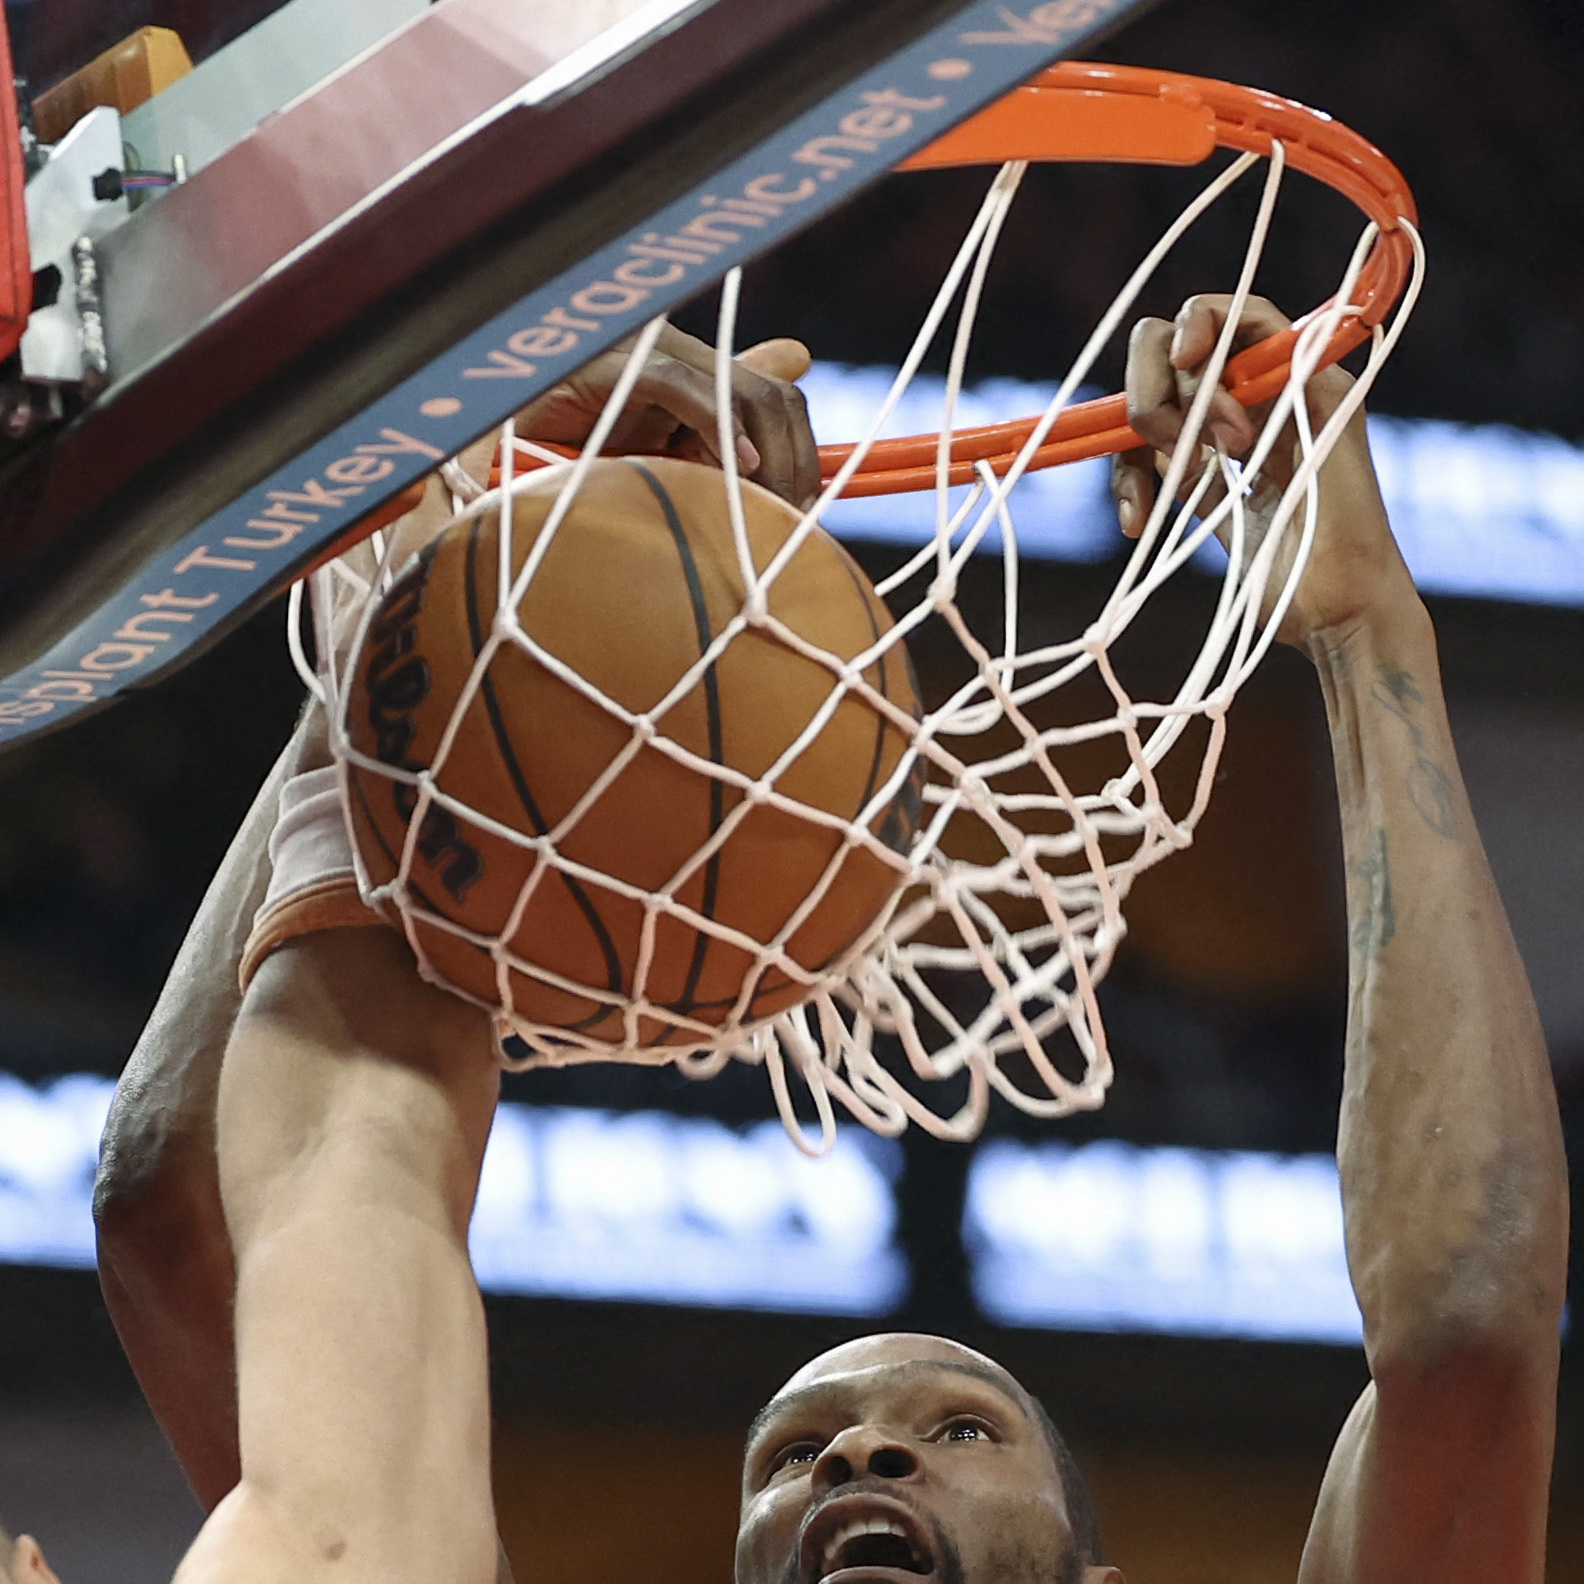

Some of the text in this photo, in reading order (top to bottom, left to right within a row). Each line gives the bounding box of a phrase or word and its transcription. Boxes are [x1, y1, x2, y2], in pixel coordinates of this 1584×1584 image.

[173, 428, 446, 573] Turkey
[462, 87, 947, 378] veraclinic.net
[958, 0, 1113, 44] Ve
